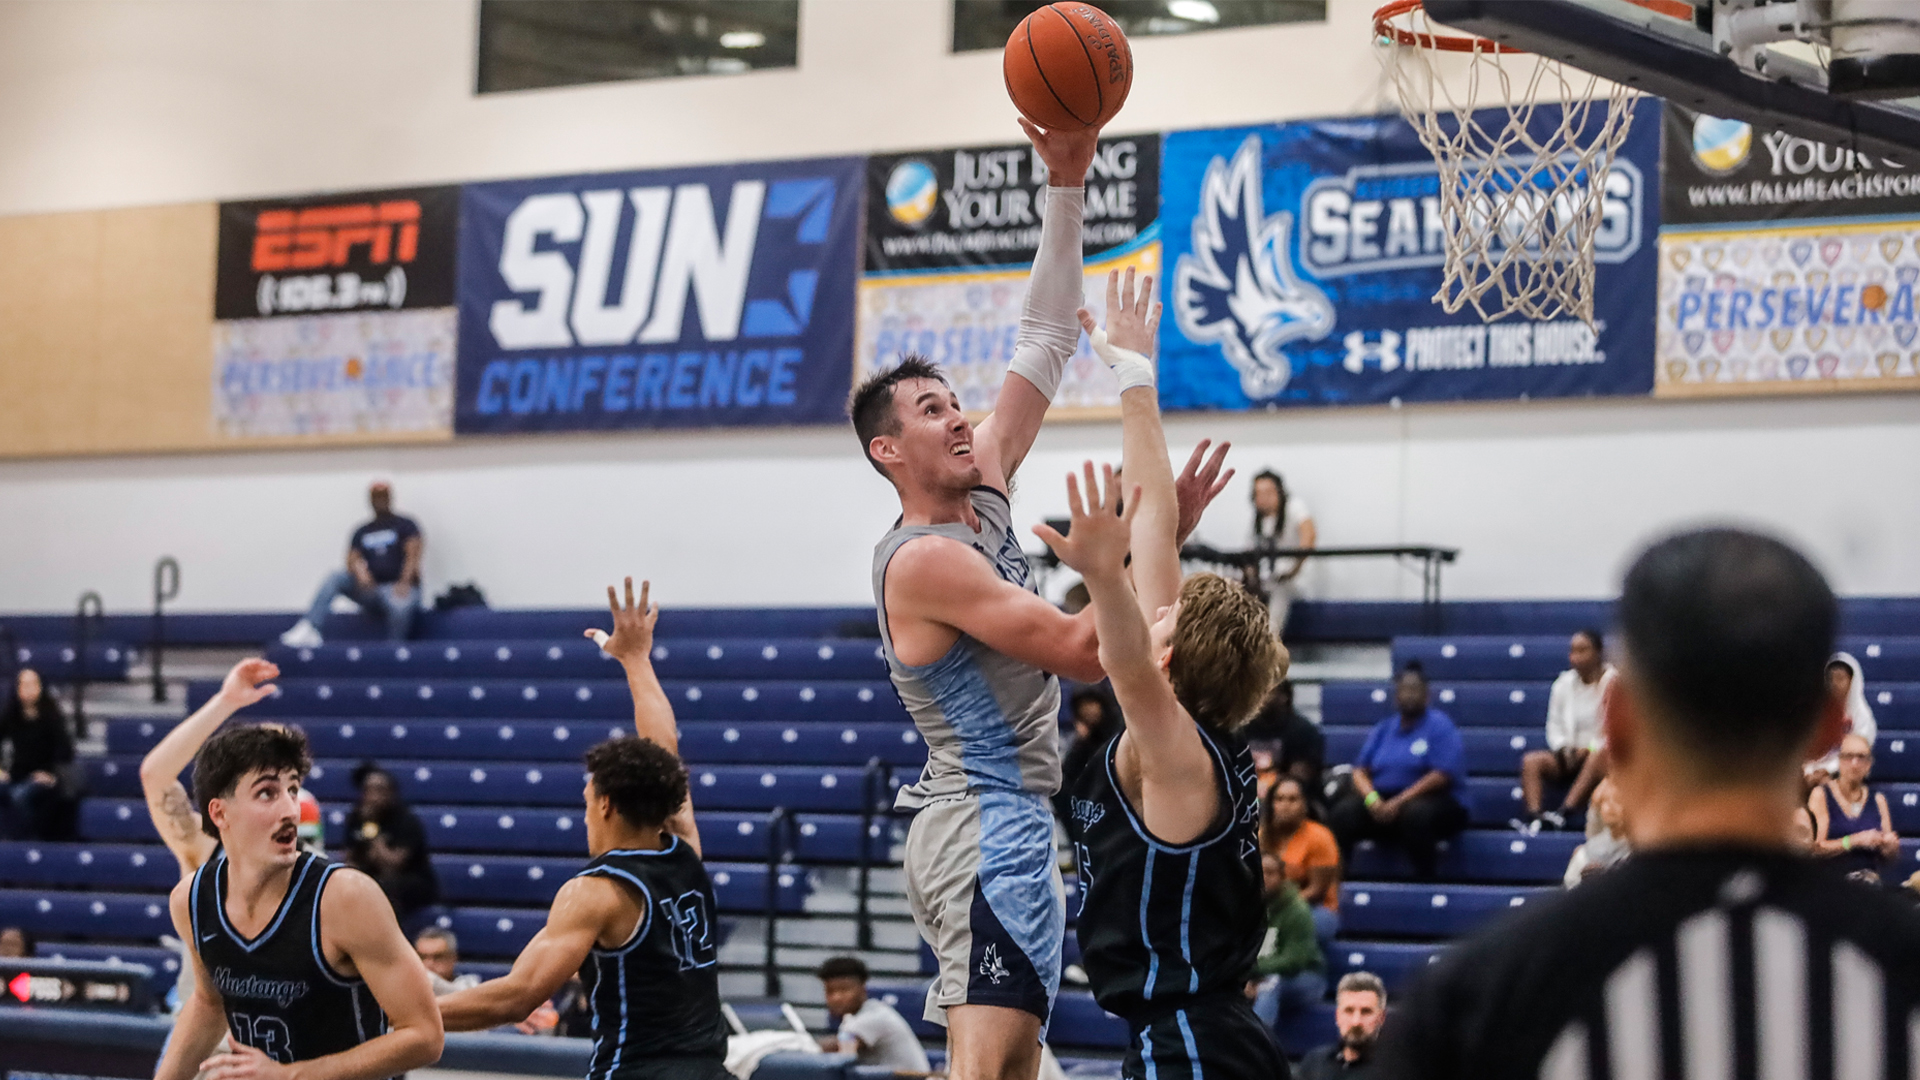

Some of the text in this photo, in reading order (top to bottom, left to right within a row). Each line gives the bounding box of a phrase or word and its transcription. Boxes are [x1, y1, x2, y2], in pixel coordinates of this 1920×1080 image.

[1077, 5, 1124, 84] SPALDING
[953, 141, 1137, 197] JUST BNG
[943, 181, 1138, 228] YOUR ME
[252, 200, 421, 271] ESPN
[488, 180, 766, 350] SUN
[221, 352, 440, 396] PERSEVEANCE
[1405, 325, 1486, 371] PROTECT
[1488, 321, 1533, 367] THIS
[476, 347, 804, 414] CONFERENCE
[659, 889, 717, 972] 12
[213, 966, 310, 1009] Mustangs
[232, 1011, 295, 1064] 13
